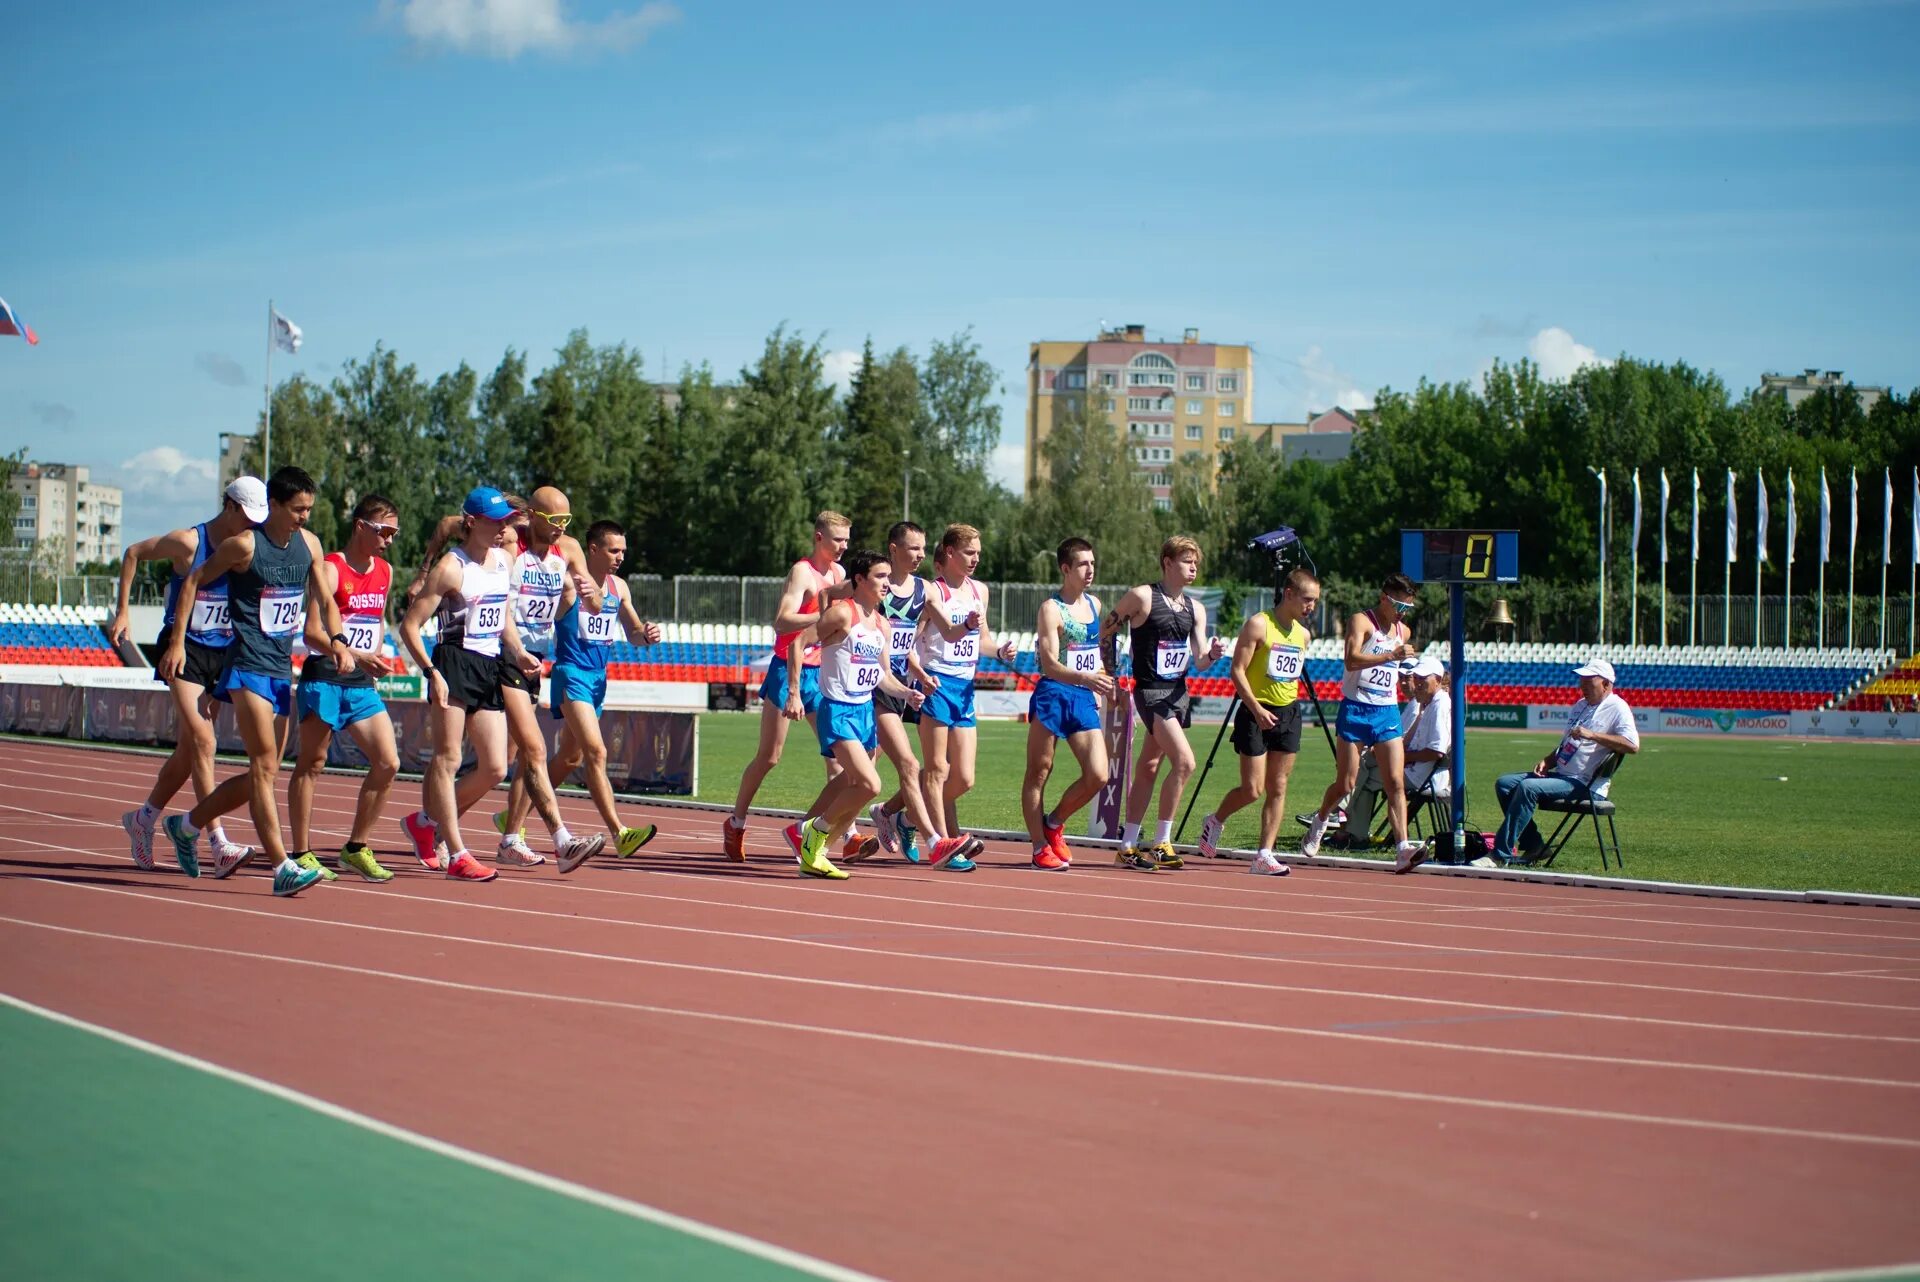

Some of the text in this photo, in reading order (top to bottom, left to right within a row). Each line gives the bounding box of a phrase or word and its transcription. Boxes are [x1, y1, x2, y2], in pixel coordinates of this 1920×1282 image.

[1463, 534, 1493, 578] 0
[522, 570, 561, 586] RUSSIA
[348, 593, 384, 609] RUSSIA
[526, 599, 554, 619] 221
[205, 605, 231, 624] 719
[272, 602, 299, 625] 729
[479, 607, 500, 627] 533
[587, 616, 611, 636] 891
[348, 627, 373, 650] 723
[892, 631, 913, 650] 848
[953, 640, 974, 657] 535
[1075, 653, 1095, 671] 849
[1164, 652, 1186, 669] 847
[1276, 655, 1297, 674] 526
[857, 668, 879, 686] 843
[1369, 668, 1392, 688] 229
[1482, 711, 1519, 721] ТОЧКА
[1666, 717, 1787, 729] АККОНД МОЛОКО
[1104, 706, 1122, 806] LYNX
